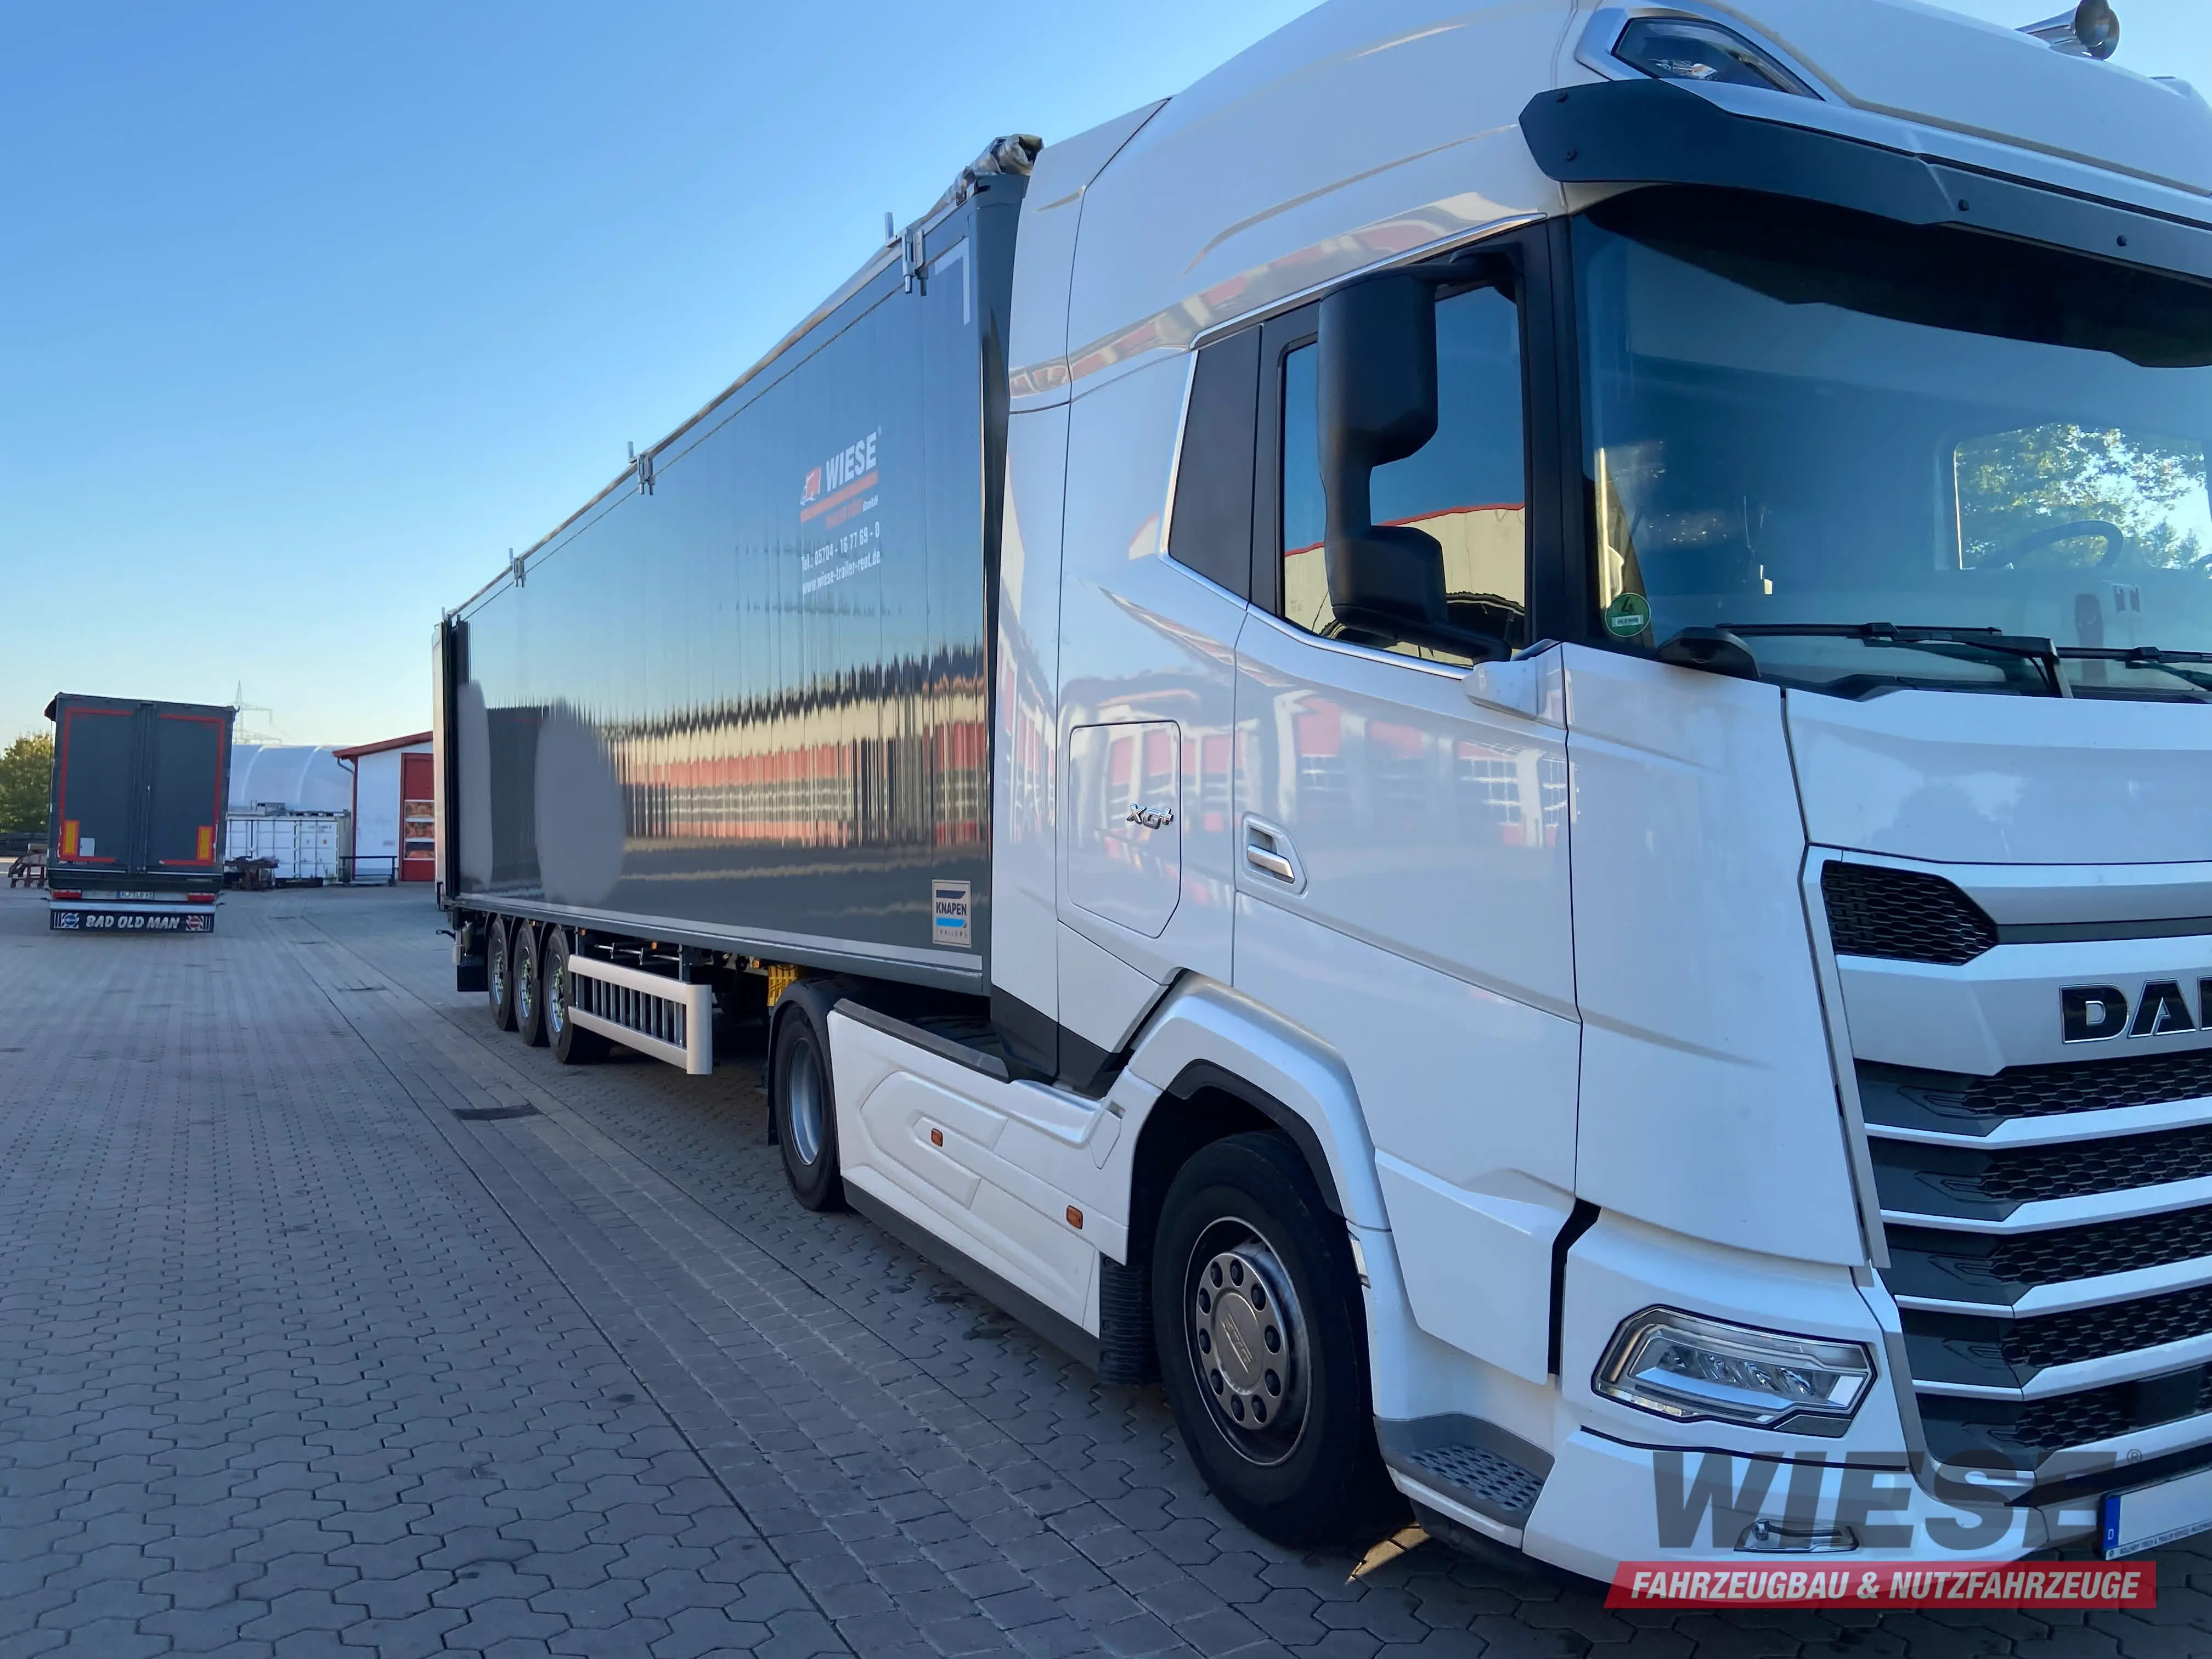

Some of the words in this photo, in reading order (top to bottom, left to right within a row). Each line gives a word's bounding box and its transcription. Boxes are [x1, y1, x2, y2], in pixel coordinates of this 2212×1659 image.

[826, 431, 877, 493] WIESE
[862, 494, 878, 513] GmbH
[801, 554, 814, 572] Tel.:
[815, 543, 833, 567] 05704
[840, 536, 848, 554] 16
[850, 532, 857, 549] 77
[859, 527, 868, 545] 69
[875, 521, 880, 538] 0
[802, 548, 881, 595] www.wiese-trailer-rent.de
[1621, 596, 1635, 615] 4
[936, 901, 967, 916] KNAPEN
[86, 915, 114, 928] BAD
[117, 916, 145, 929] OLD
[146, 917, 180, 929] MAN
[936, 929, 967, 938] TRAILERS
[2059, 976, 2212, 1044] DA
[2108, 1528, 2114, 1540] D
